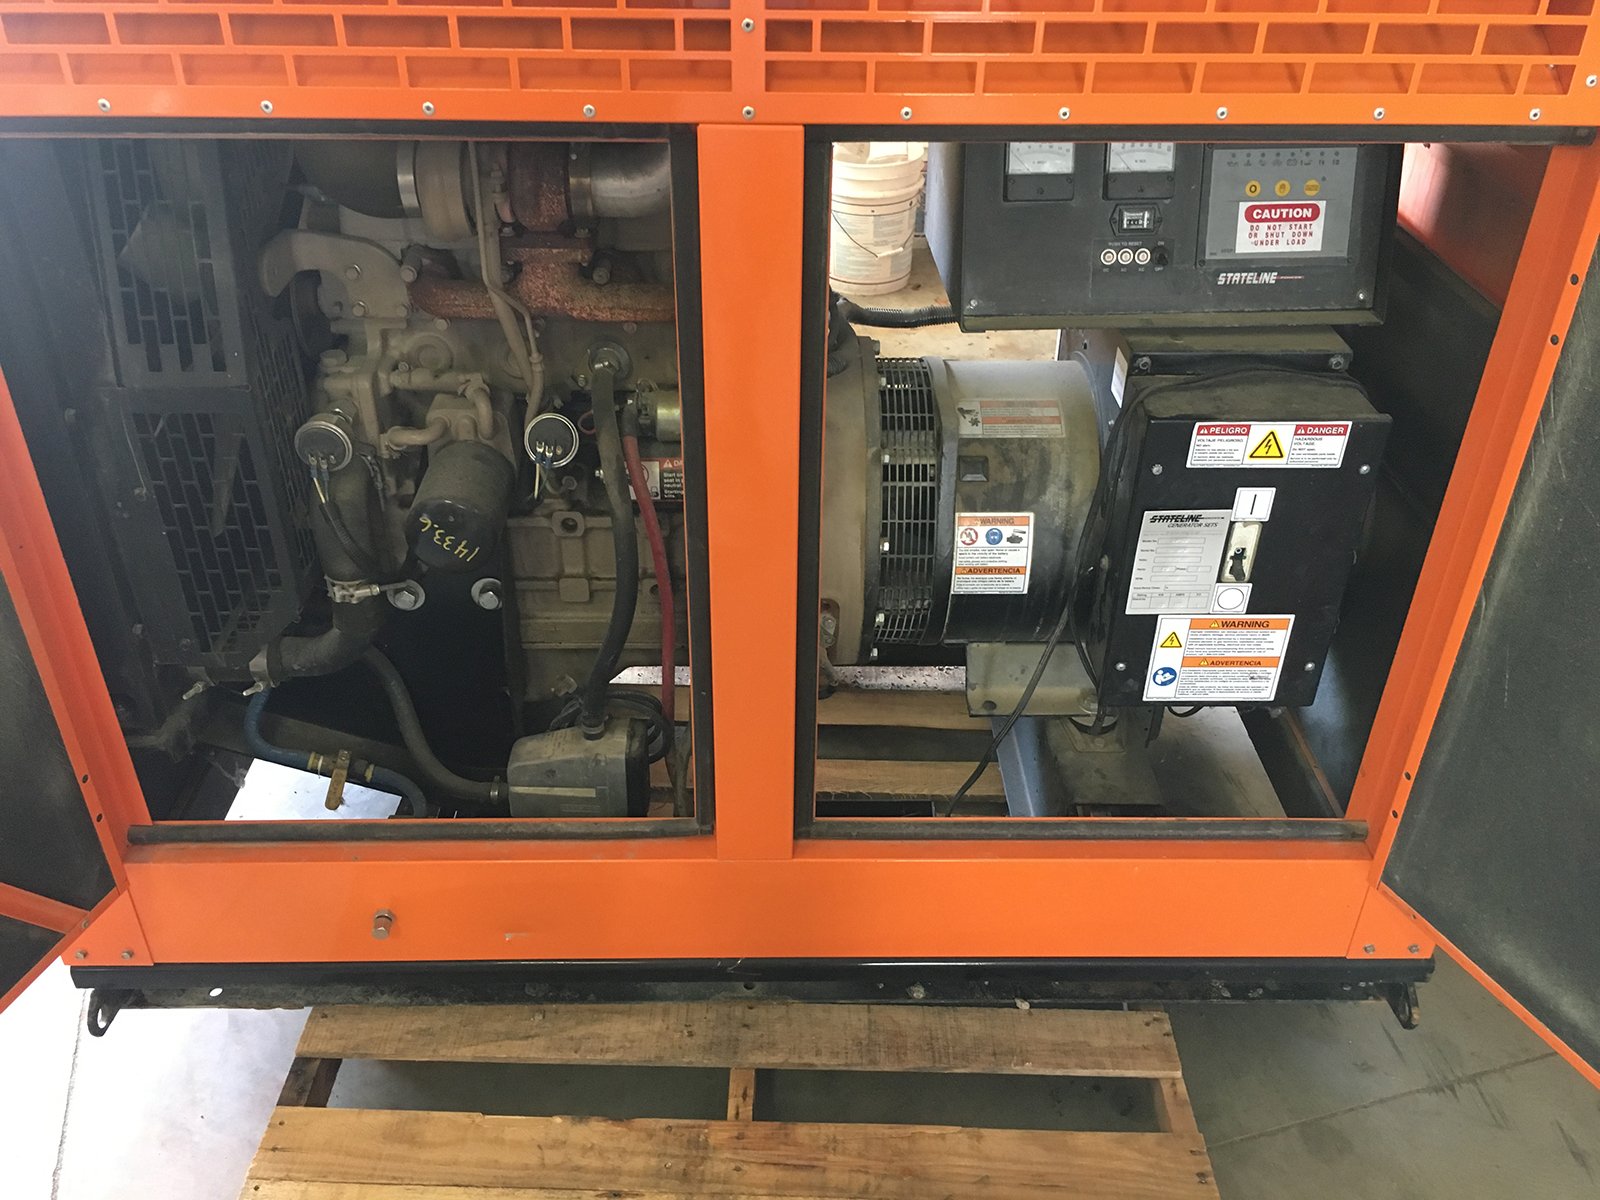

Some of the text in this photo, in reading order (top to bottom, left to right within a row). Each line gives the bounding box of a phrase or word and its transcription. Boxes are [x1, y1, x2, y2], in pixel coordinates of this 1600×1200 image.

[1253, 208, 1312, 220] CAUTION
[1217, 272, 1278, 285] STATELINE
[1209, 426, 1248, 435] PELIGRO
[1306, 426, 1345, 435] DANGER
[1150, 514, 1203, 523] STATELINE
[1221, 620, 1270, 628] WARNING
